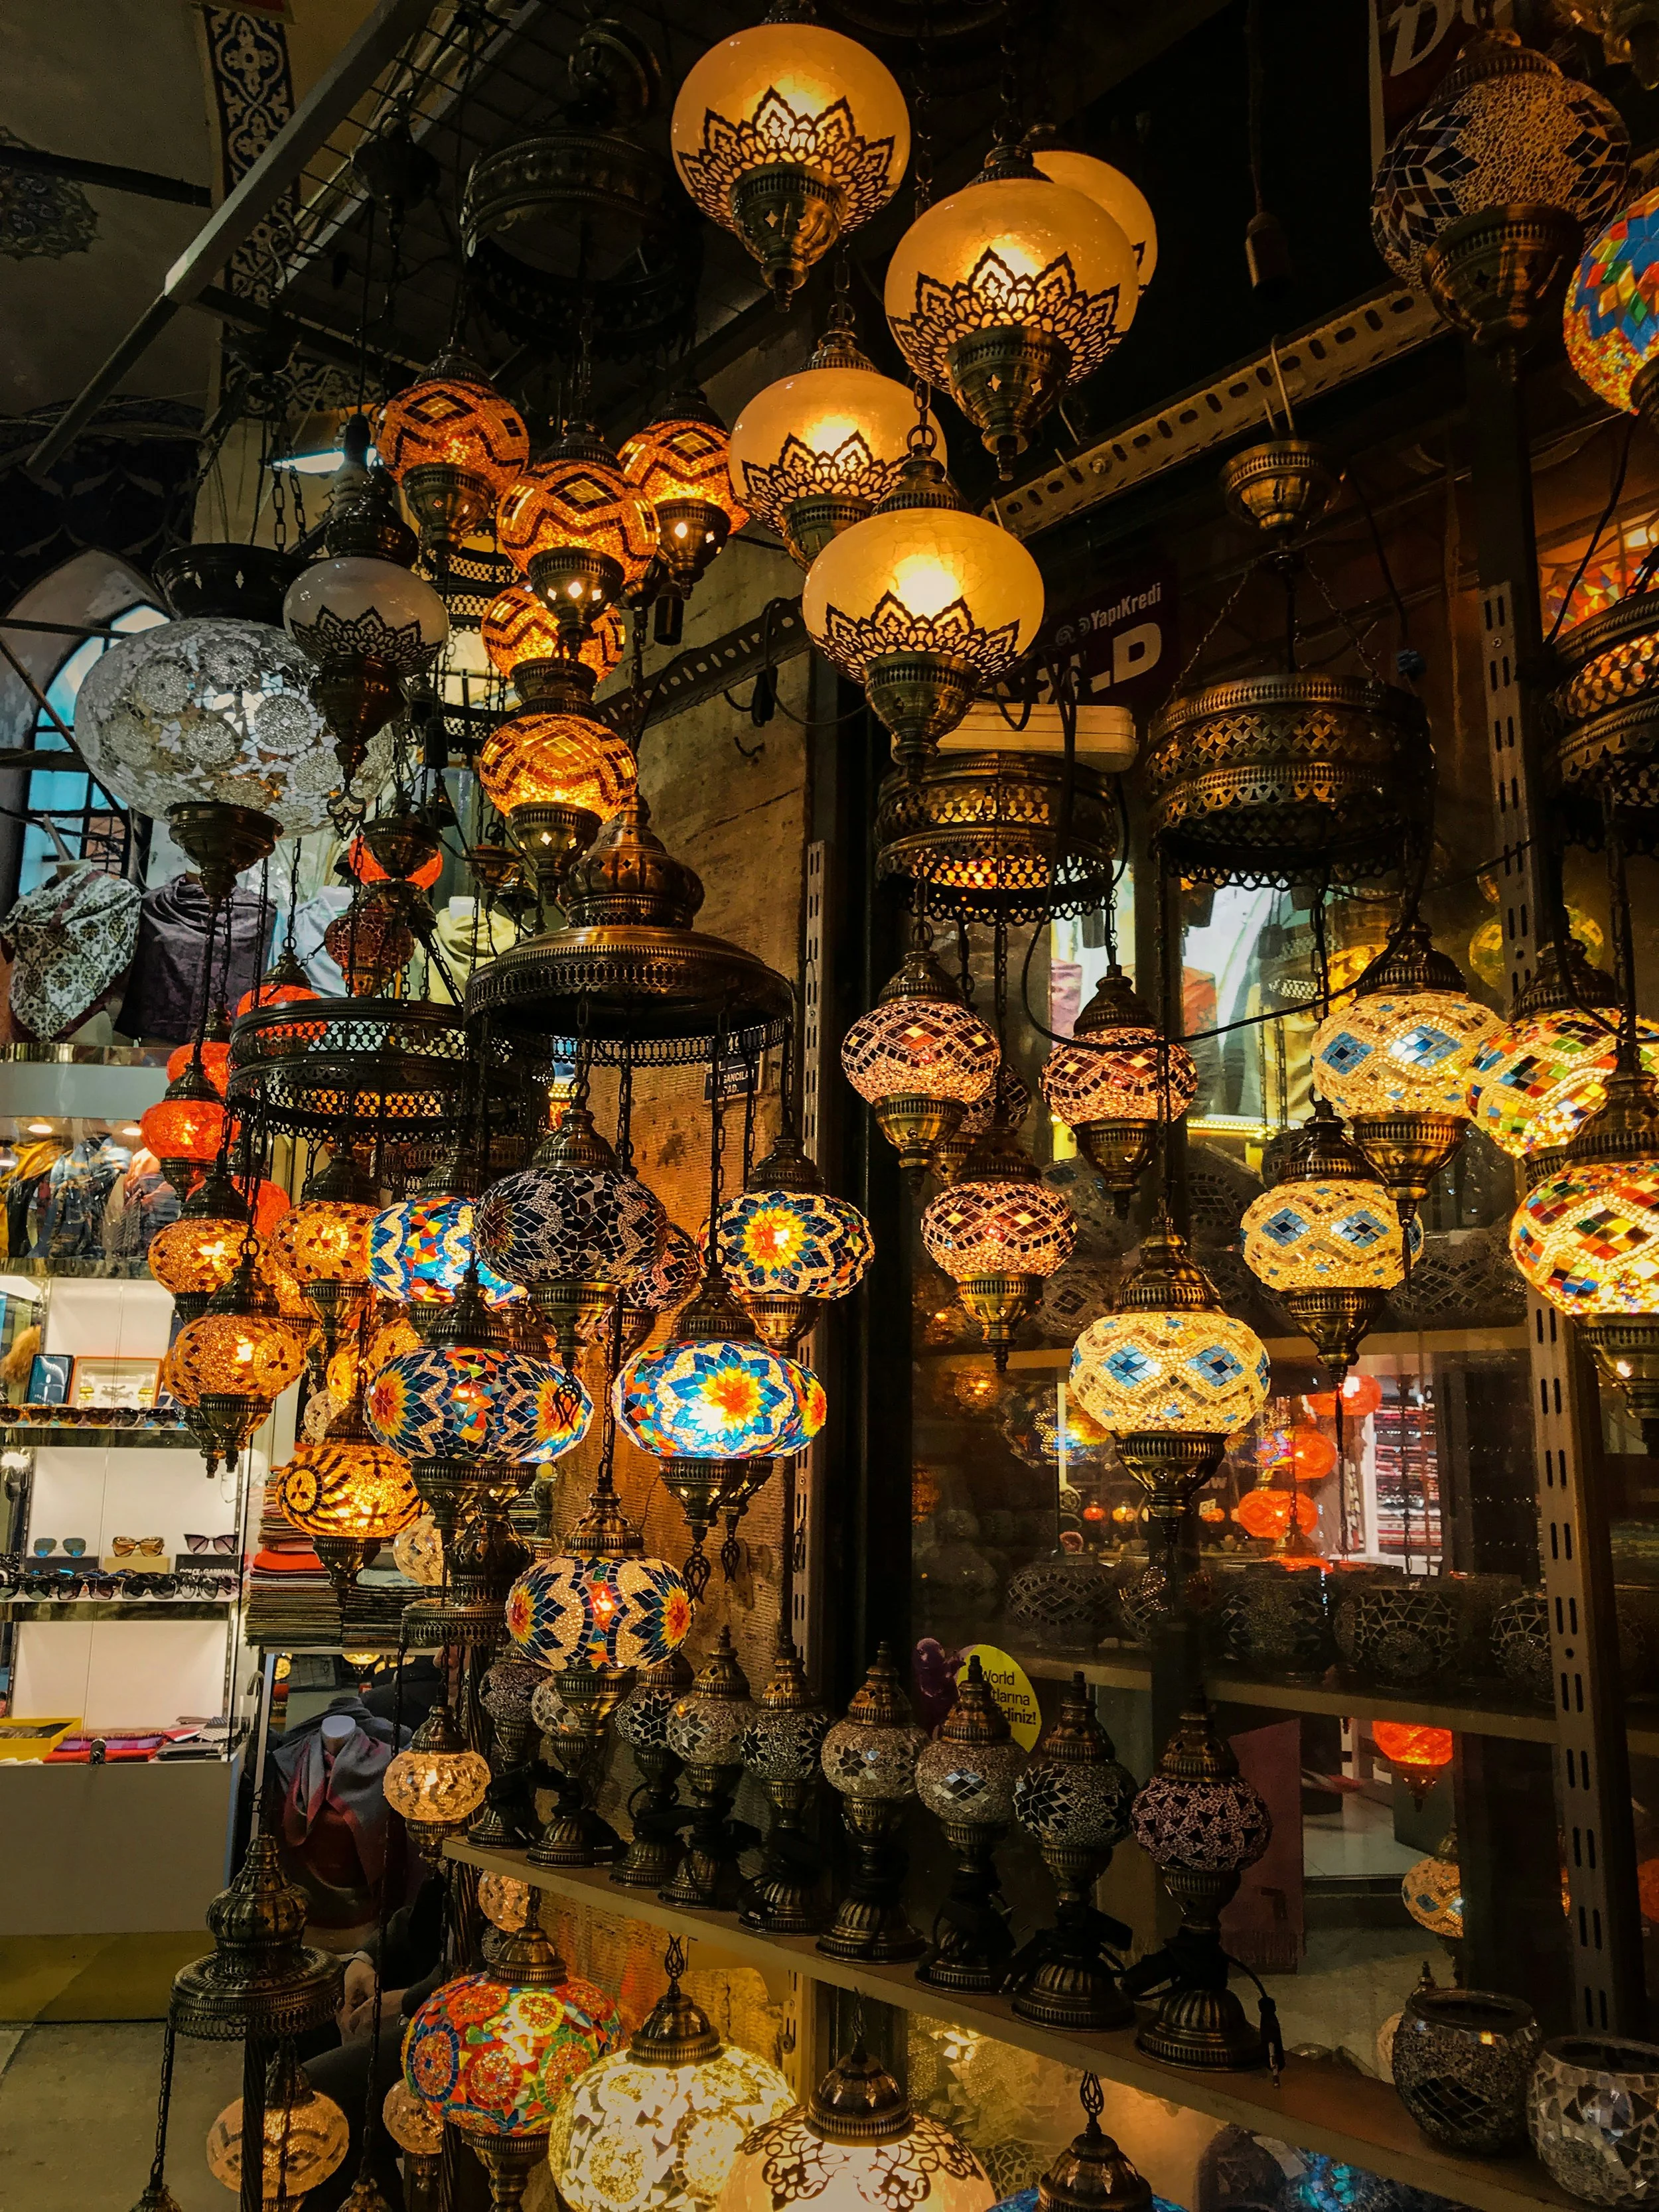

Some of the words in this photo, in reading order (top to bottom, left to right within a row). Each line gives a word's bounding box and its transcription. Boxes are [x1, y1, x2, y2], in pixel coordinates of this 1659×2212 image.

[983, 1669, 1015, 1685] World
[991, 1688, 1030, 1706] tlarına
[1003, 1707, 1037, 1725] diniz!
